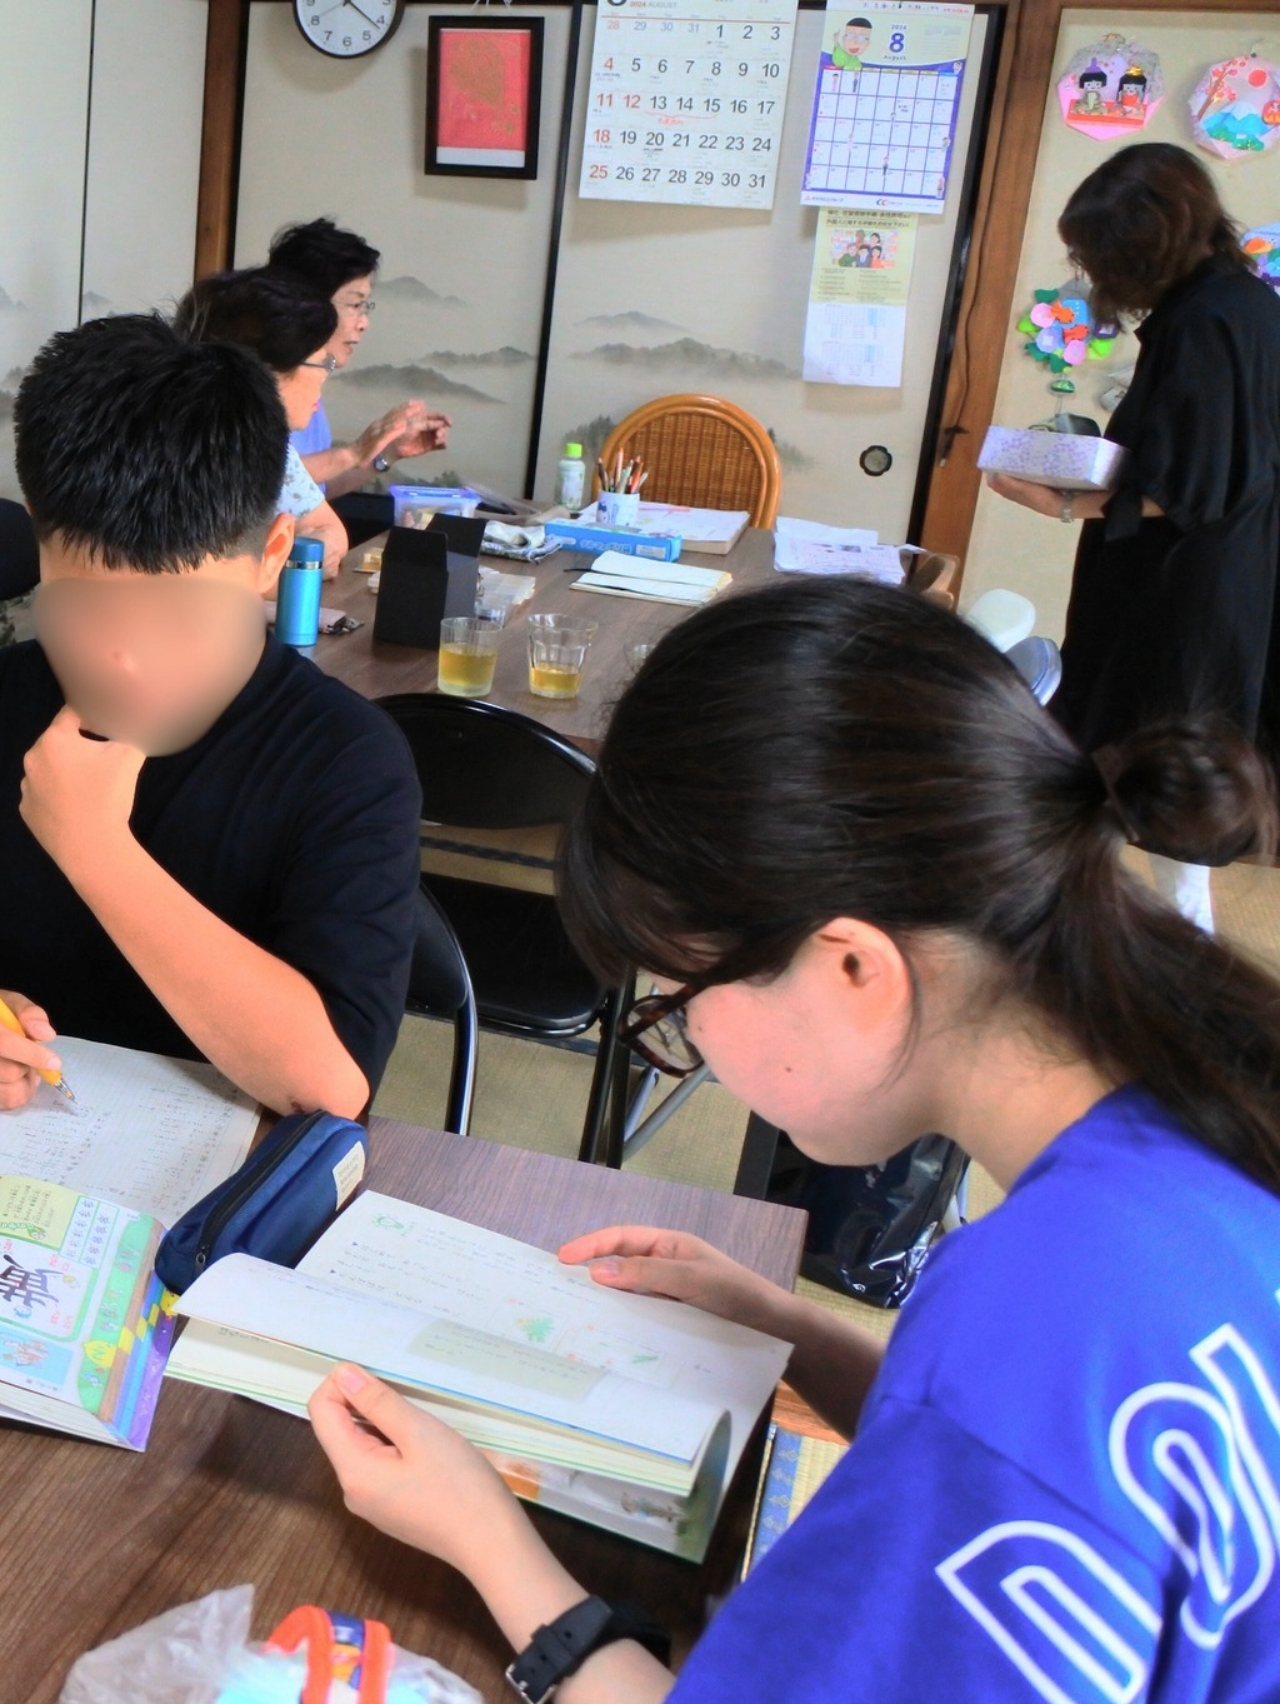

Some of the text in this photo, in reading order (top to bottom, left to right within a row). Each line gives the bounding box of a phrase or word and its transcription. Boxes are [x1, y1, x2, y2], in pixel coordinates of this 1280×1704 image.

[311, 15, 320, 25] 8
[376, 15, 385, 24] 4
[324, 31, 332, 41] 7
[363, 31, 371, 40] 5
[608, 21, 780, 40] 28 29 30 31 1 2 3
[343, 37, 351, 46] 6
[889, 33, 904, 53] 8
[604, 58, 779, 77] 4 5 6 7 8 9 10
[597, 94, 775, 114] 11 12 13 14 15 16 17
[593, 129, 771, 151] 18 19 20 21 22 23 24
[590, 165, 766, 188] 25 26 27 28 29 30 31
